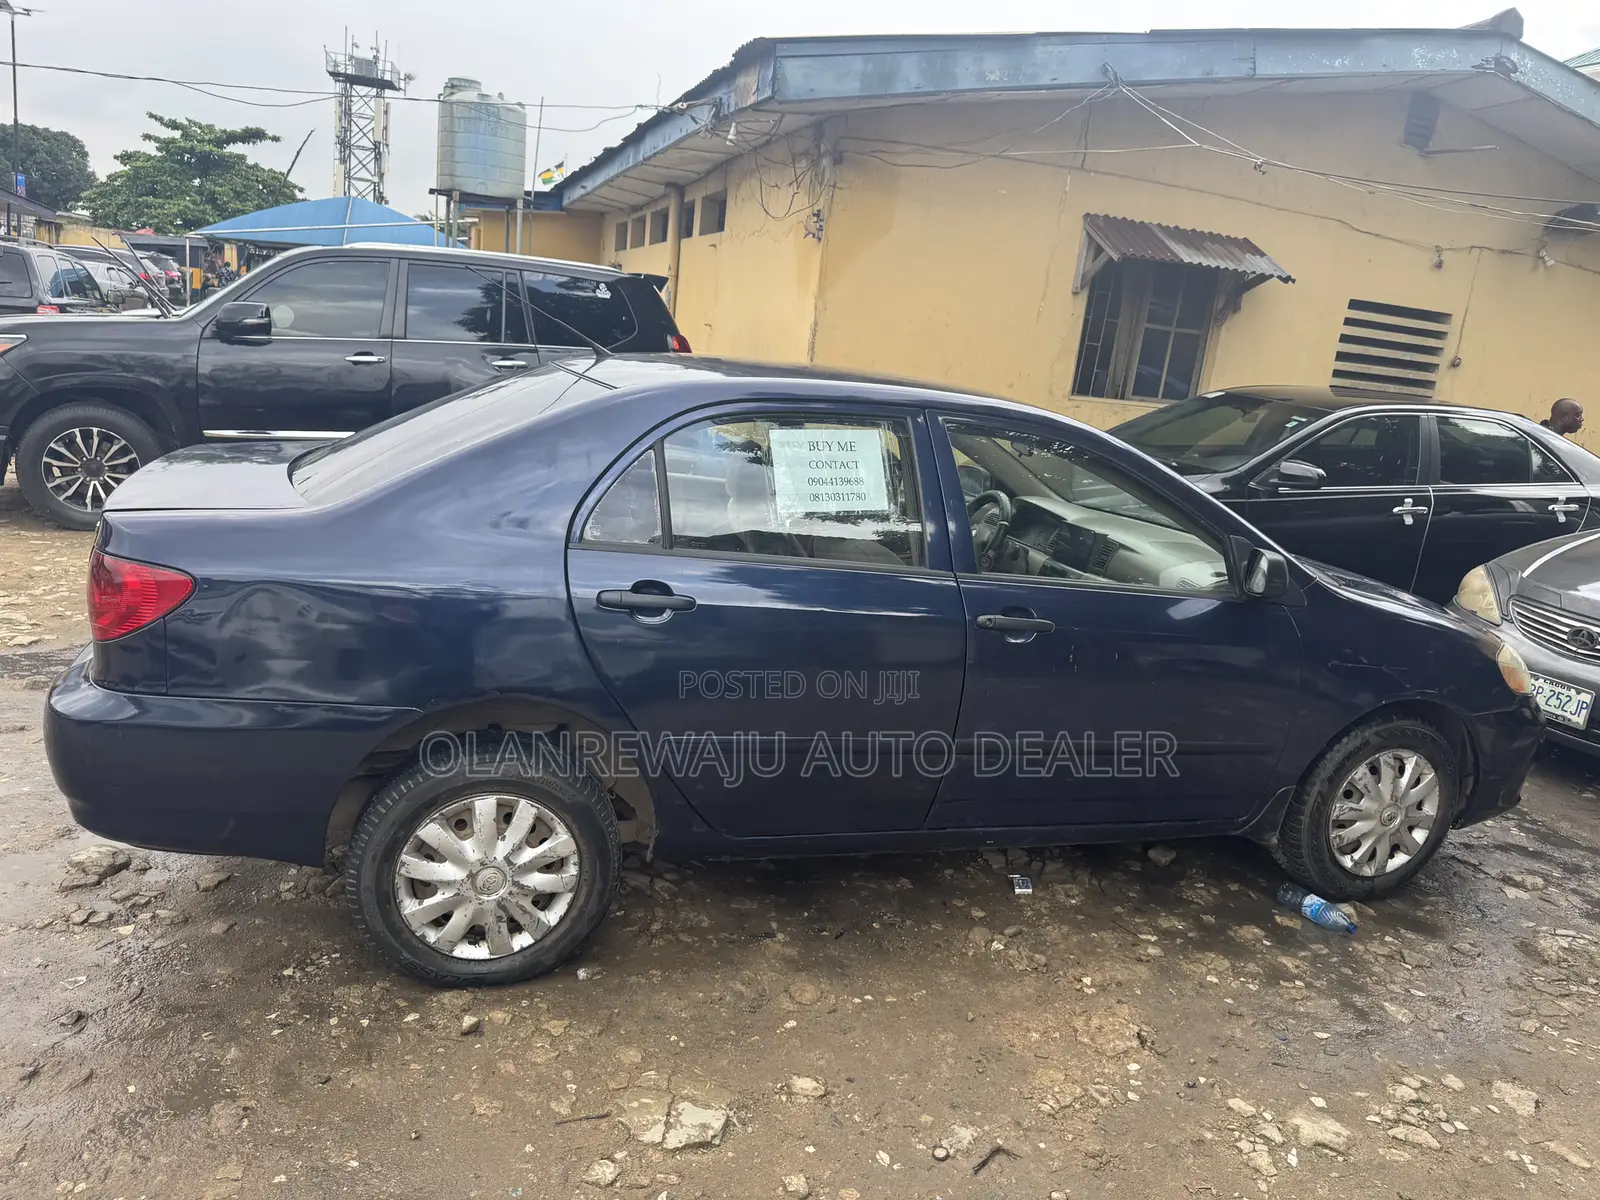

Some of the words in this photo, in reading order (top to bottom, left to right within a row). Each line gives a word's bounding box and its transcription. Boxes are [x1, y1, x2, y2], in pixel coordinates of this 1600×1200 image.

[808, 441, 834, 452] BUY
[837, 441, 857, 452] ME
[808, 460, 860, 470] CONTACT
[807, 477, 865, 486] 09044139688
[809, 492, 867, 502] 08130311780
[1543, 679, 1572, 692] LAGOS
